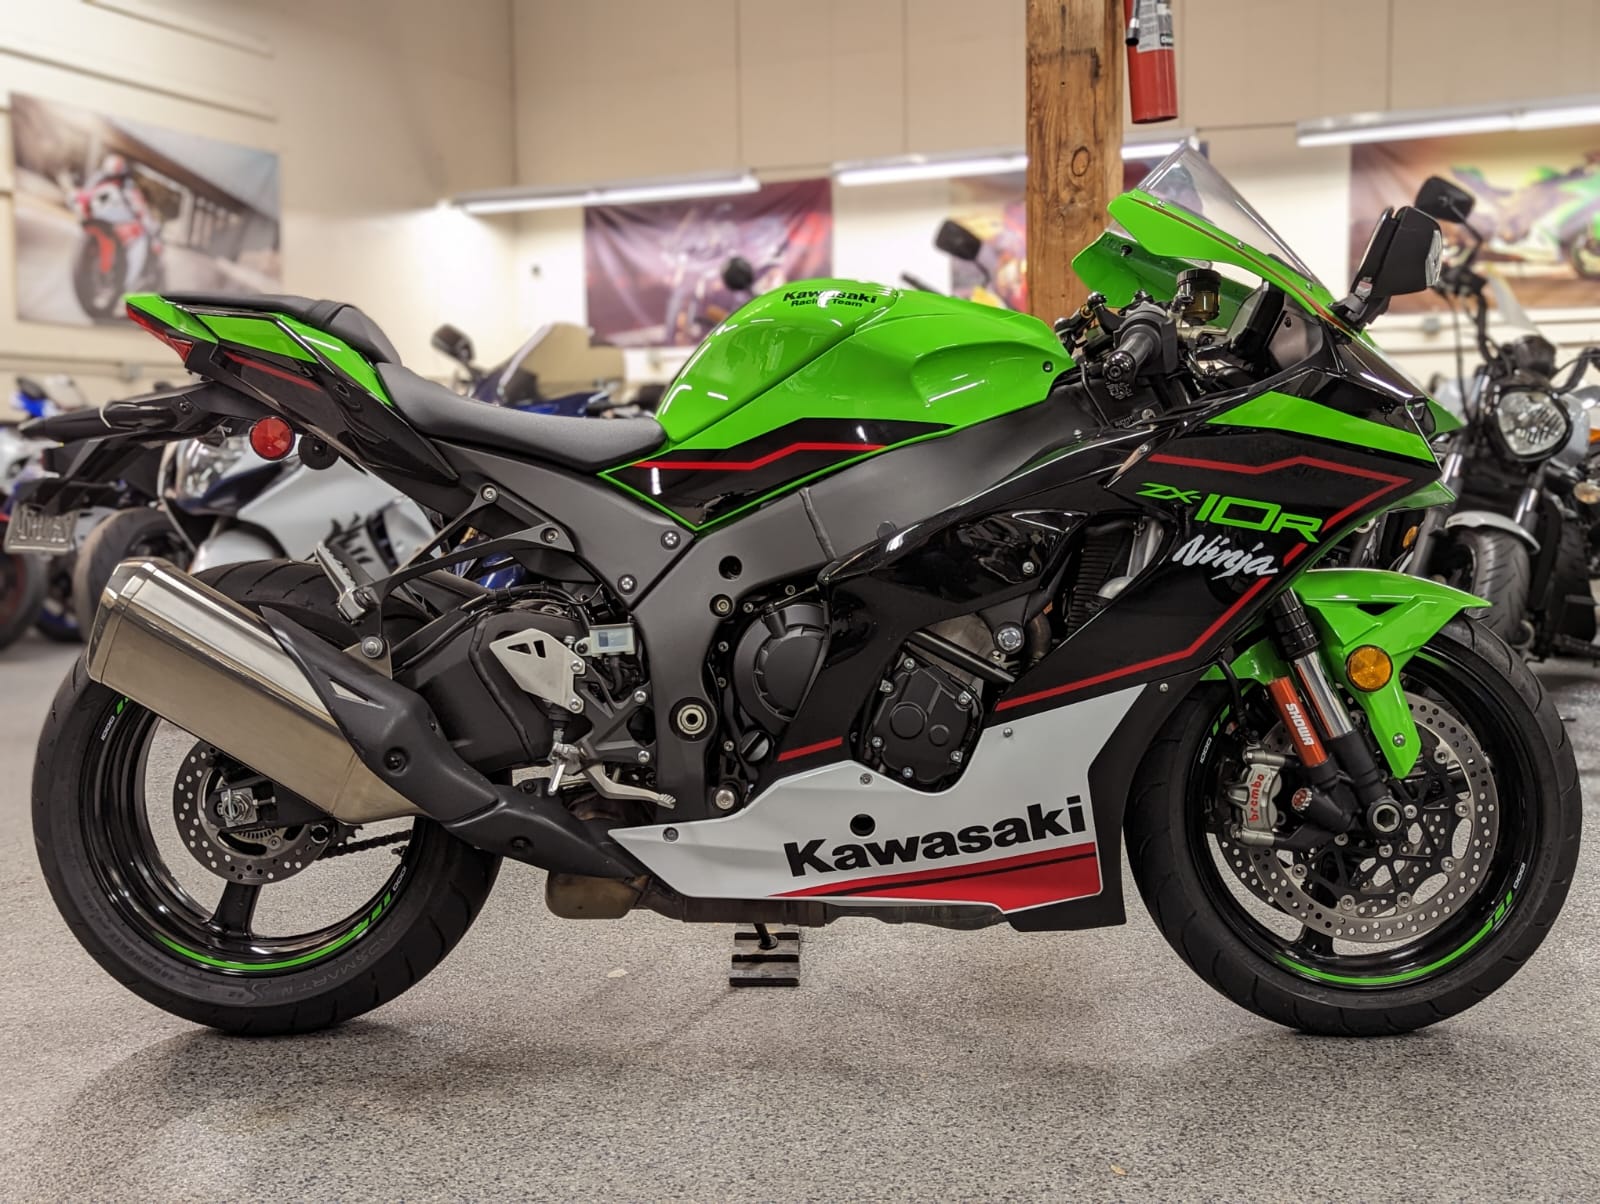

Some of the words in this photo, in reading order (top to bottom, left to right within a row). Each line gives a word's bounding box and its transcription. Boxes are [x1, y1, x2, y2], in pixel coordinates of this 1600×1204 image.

[783, 290, 878, 304] Kawsaki
[832, 298, 863, 307] Team
[1136, 482, 1323, 543] ZX-10R
[1172, 534, 1279, 580] Ninja
[1285, 703, 1316, 746] SHOWA
[1248, 774, 1265, 821] brembo
[783, 795, 1087, 877] Kawasaki
